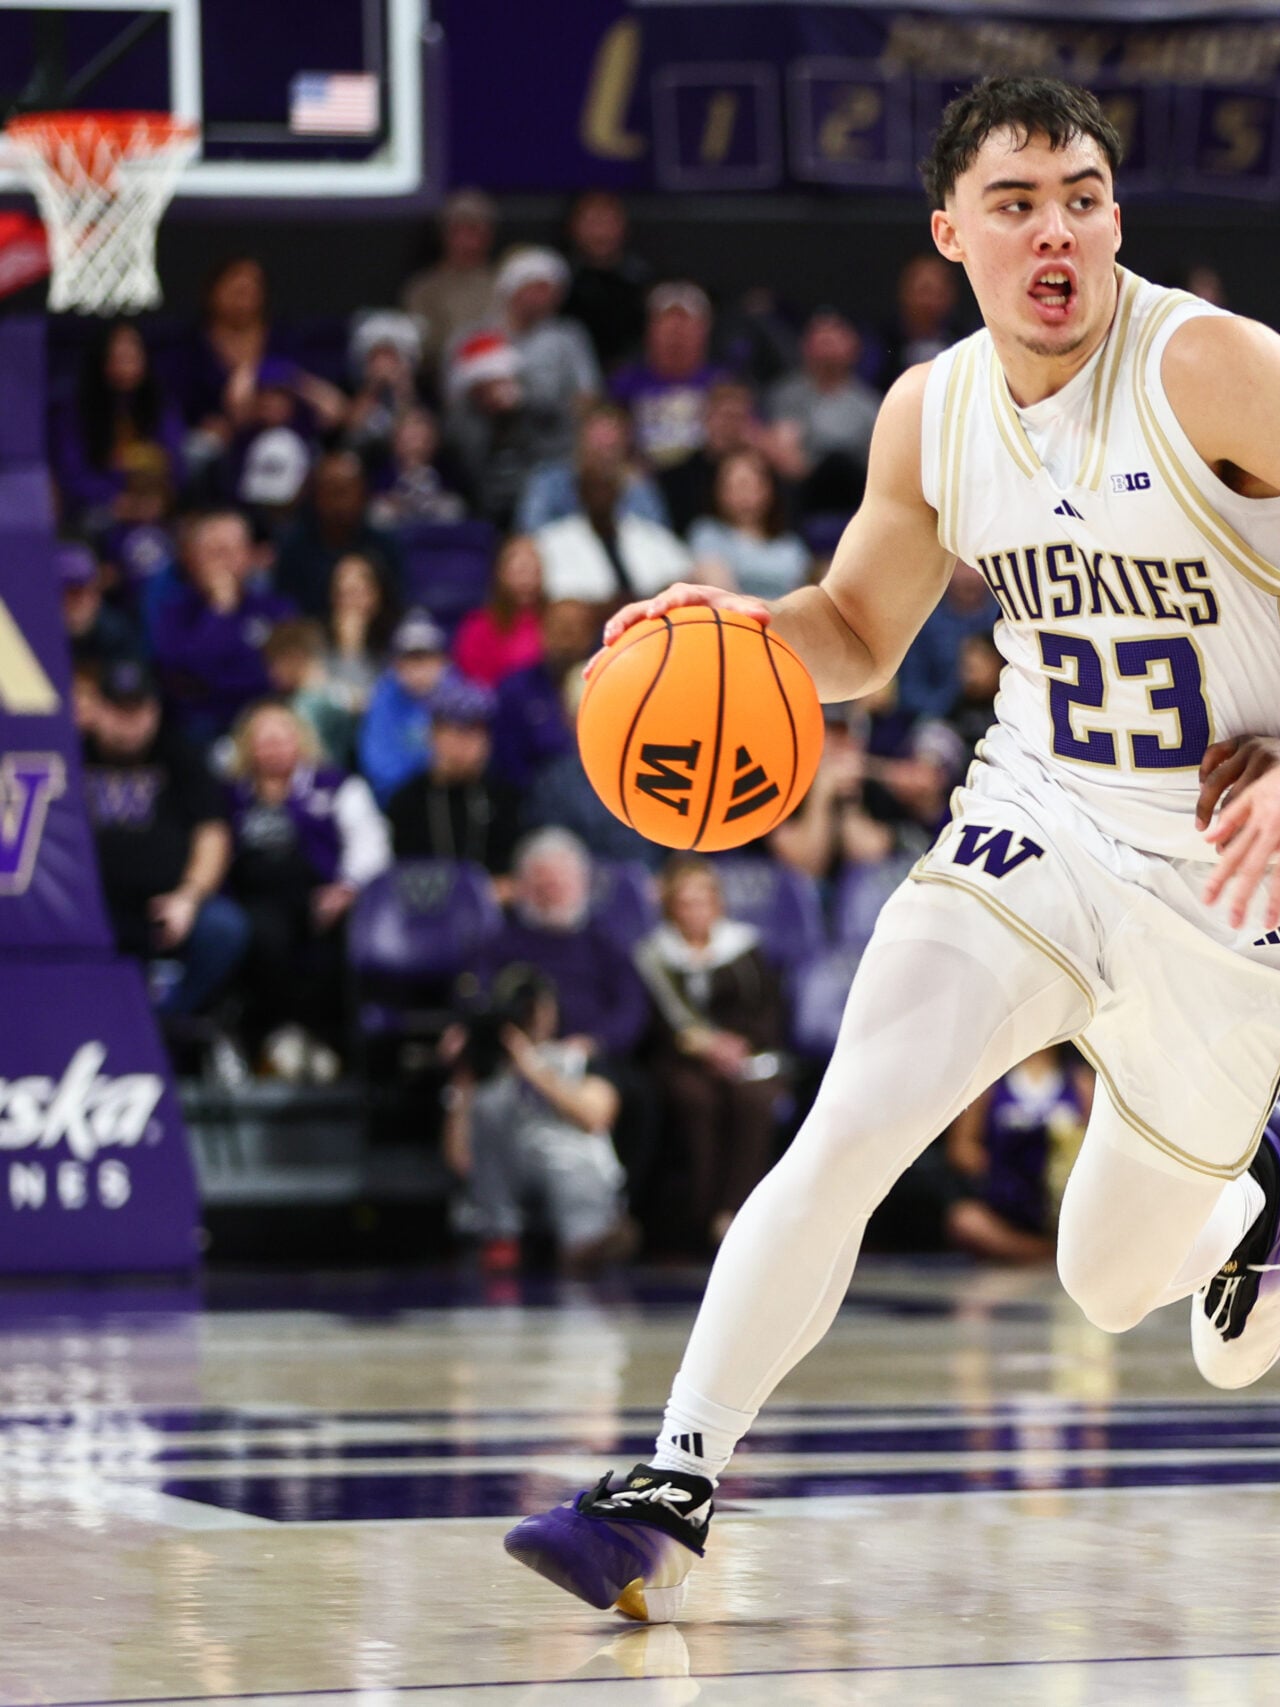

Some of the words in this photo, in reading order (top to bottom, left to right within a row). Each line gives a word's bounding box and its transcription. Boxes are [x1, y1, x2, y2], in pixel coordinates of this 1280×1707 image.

[976, 540, 1221, 628] HUSKIES
[1035, 629, 1215, 774] 23
[951, 823, 1046, 880] W
[0, 1040, 164, 1162] ska
